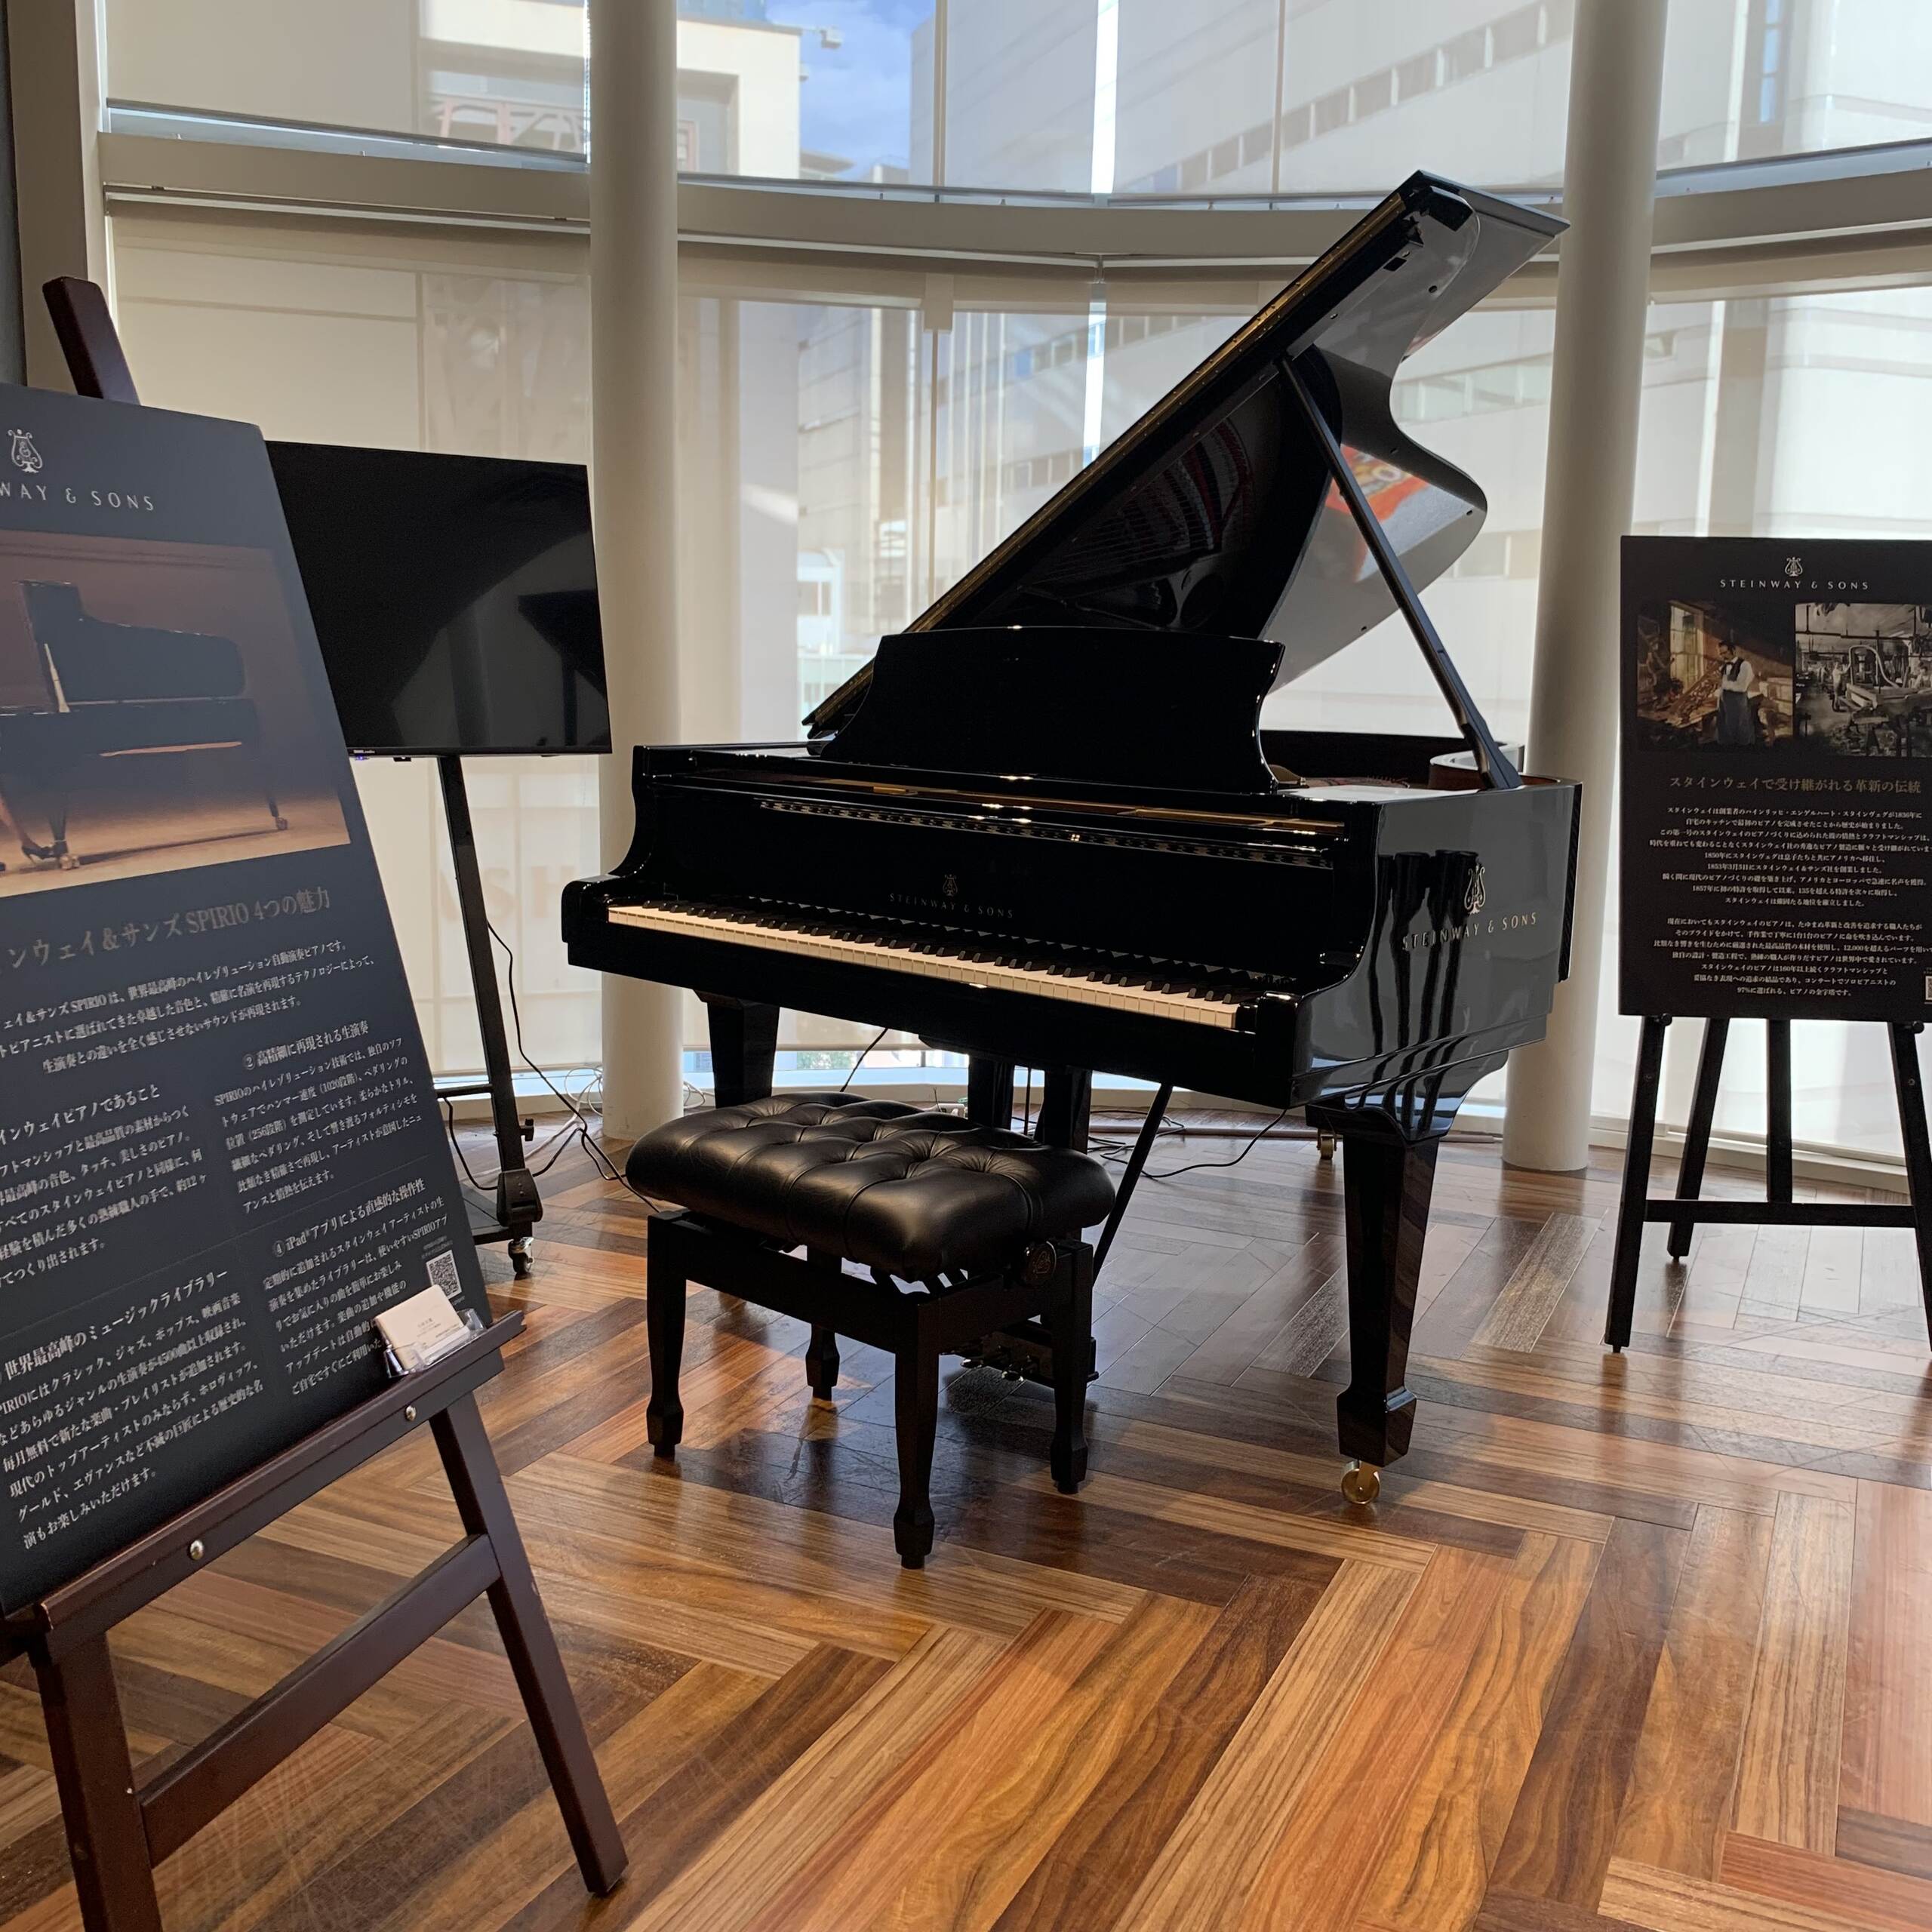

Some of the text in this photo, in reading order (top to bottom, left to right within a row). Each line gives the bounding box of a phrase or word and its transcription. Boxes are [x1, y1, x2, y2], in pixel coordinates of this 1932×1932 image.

[66, 488, 76, 503] &
[91, 491, 154, 511] SONS
[1720, 579, 1869, 590] STEINWAY & SONS
[1669, 776, 1921, 793] スタインウェイで受け継がれる革新の伝統
[890, 893, 956, 910] STEINWAY
[978, 906, 1013, 918] SONS
[186, 903, 249, 934] SPIRIO
[1402, 912, 1537, 950] STEINWAY & SONS
